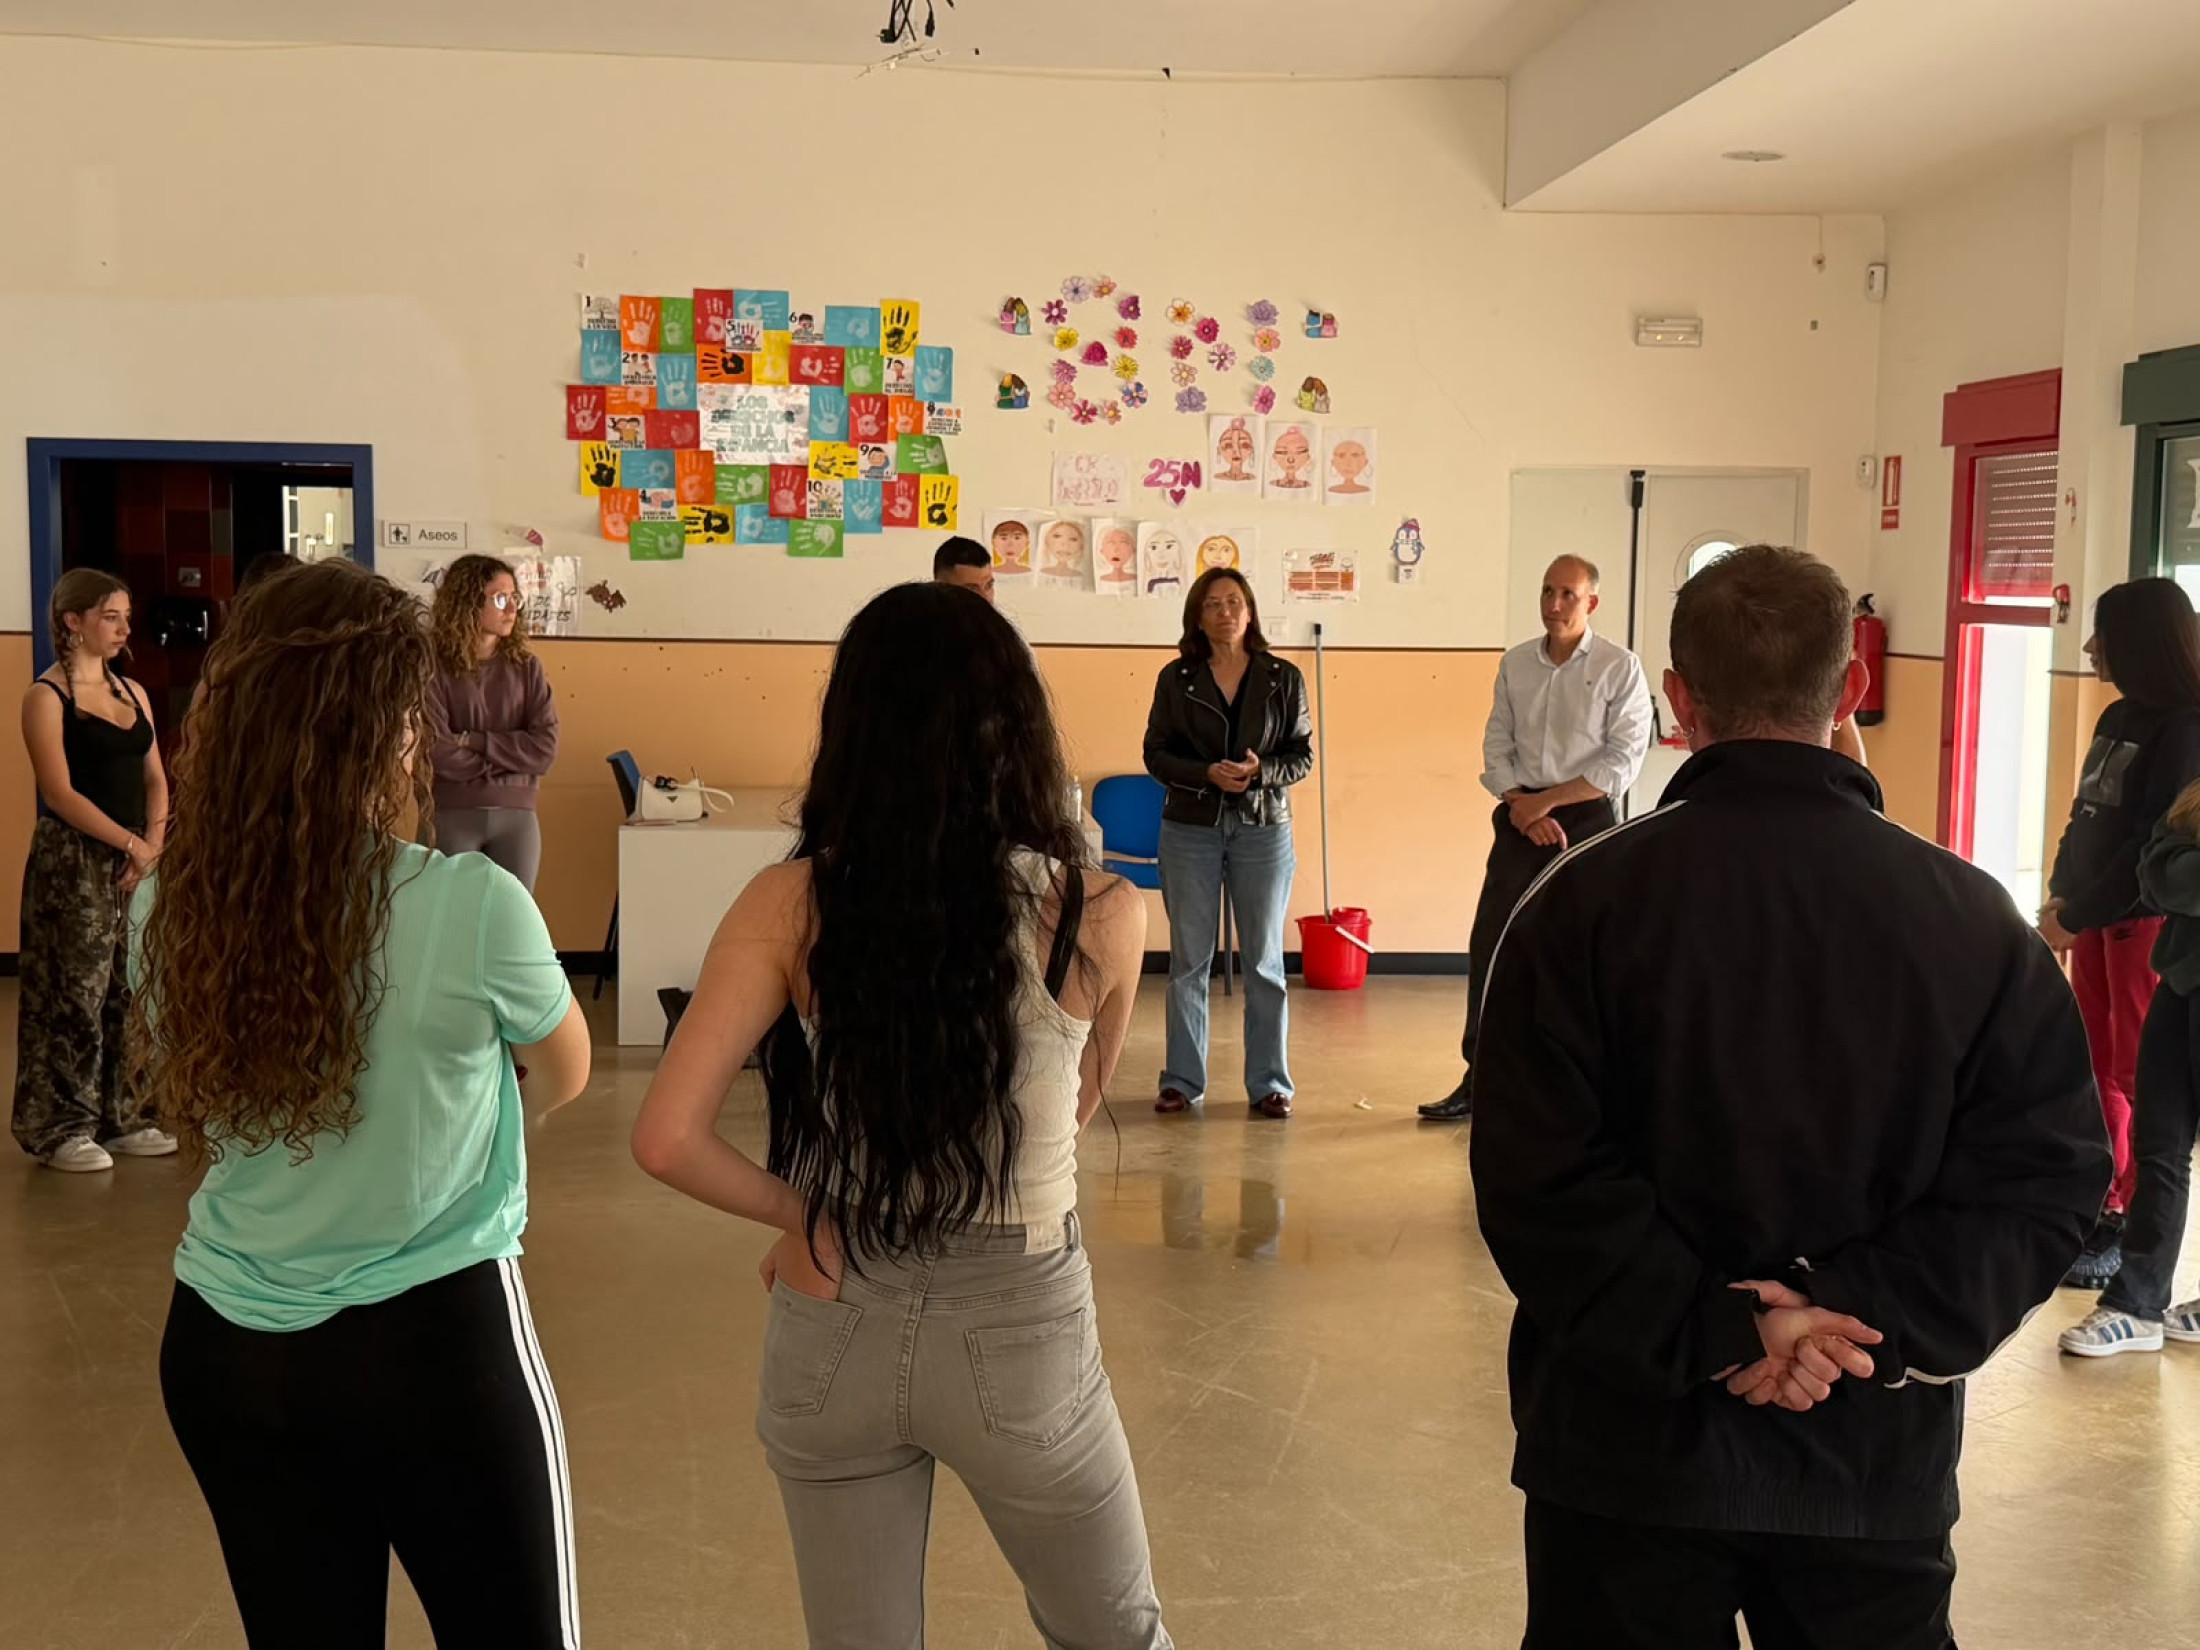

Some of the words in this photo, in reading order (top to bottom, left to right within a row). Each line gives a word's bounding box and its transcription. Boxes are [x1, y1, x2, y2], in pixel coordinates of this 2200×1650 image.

[585, 295, 592, 308] 1
[788, 312, 798, 323] 6
[726, 320, 736, 332] 5
[622, 352, 631, 364] 2
[886, 357, 893, 370] 7
[859, 444, 870, 456] 9
[1143, 458, 1202, 489] 25N
[807, 480, 822, 492] 10
[418, 529, 458, 541] Aseos
